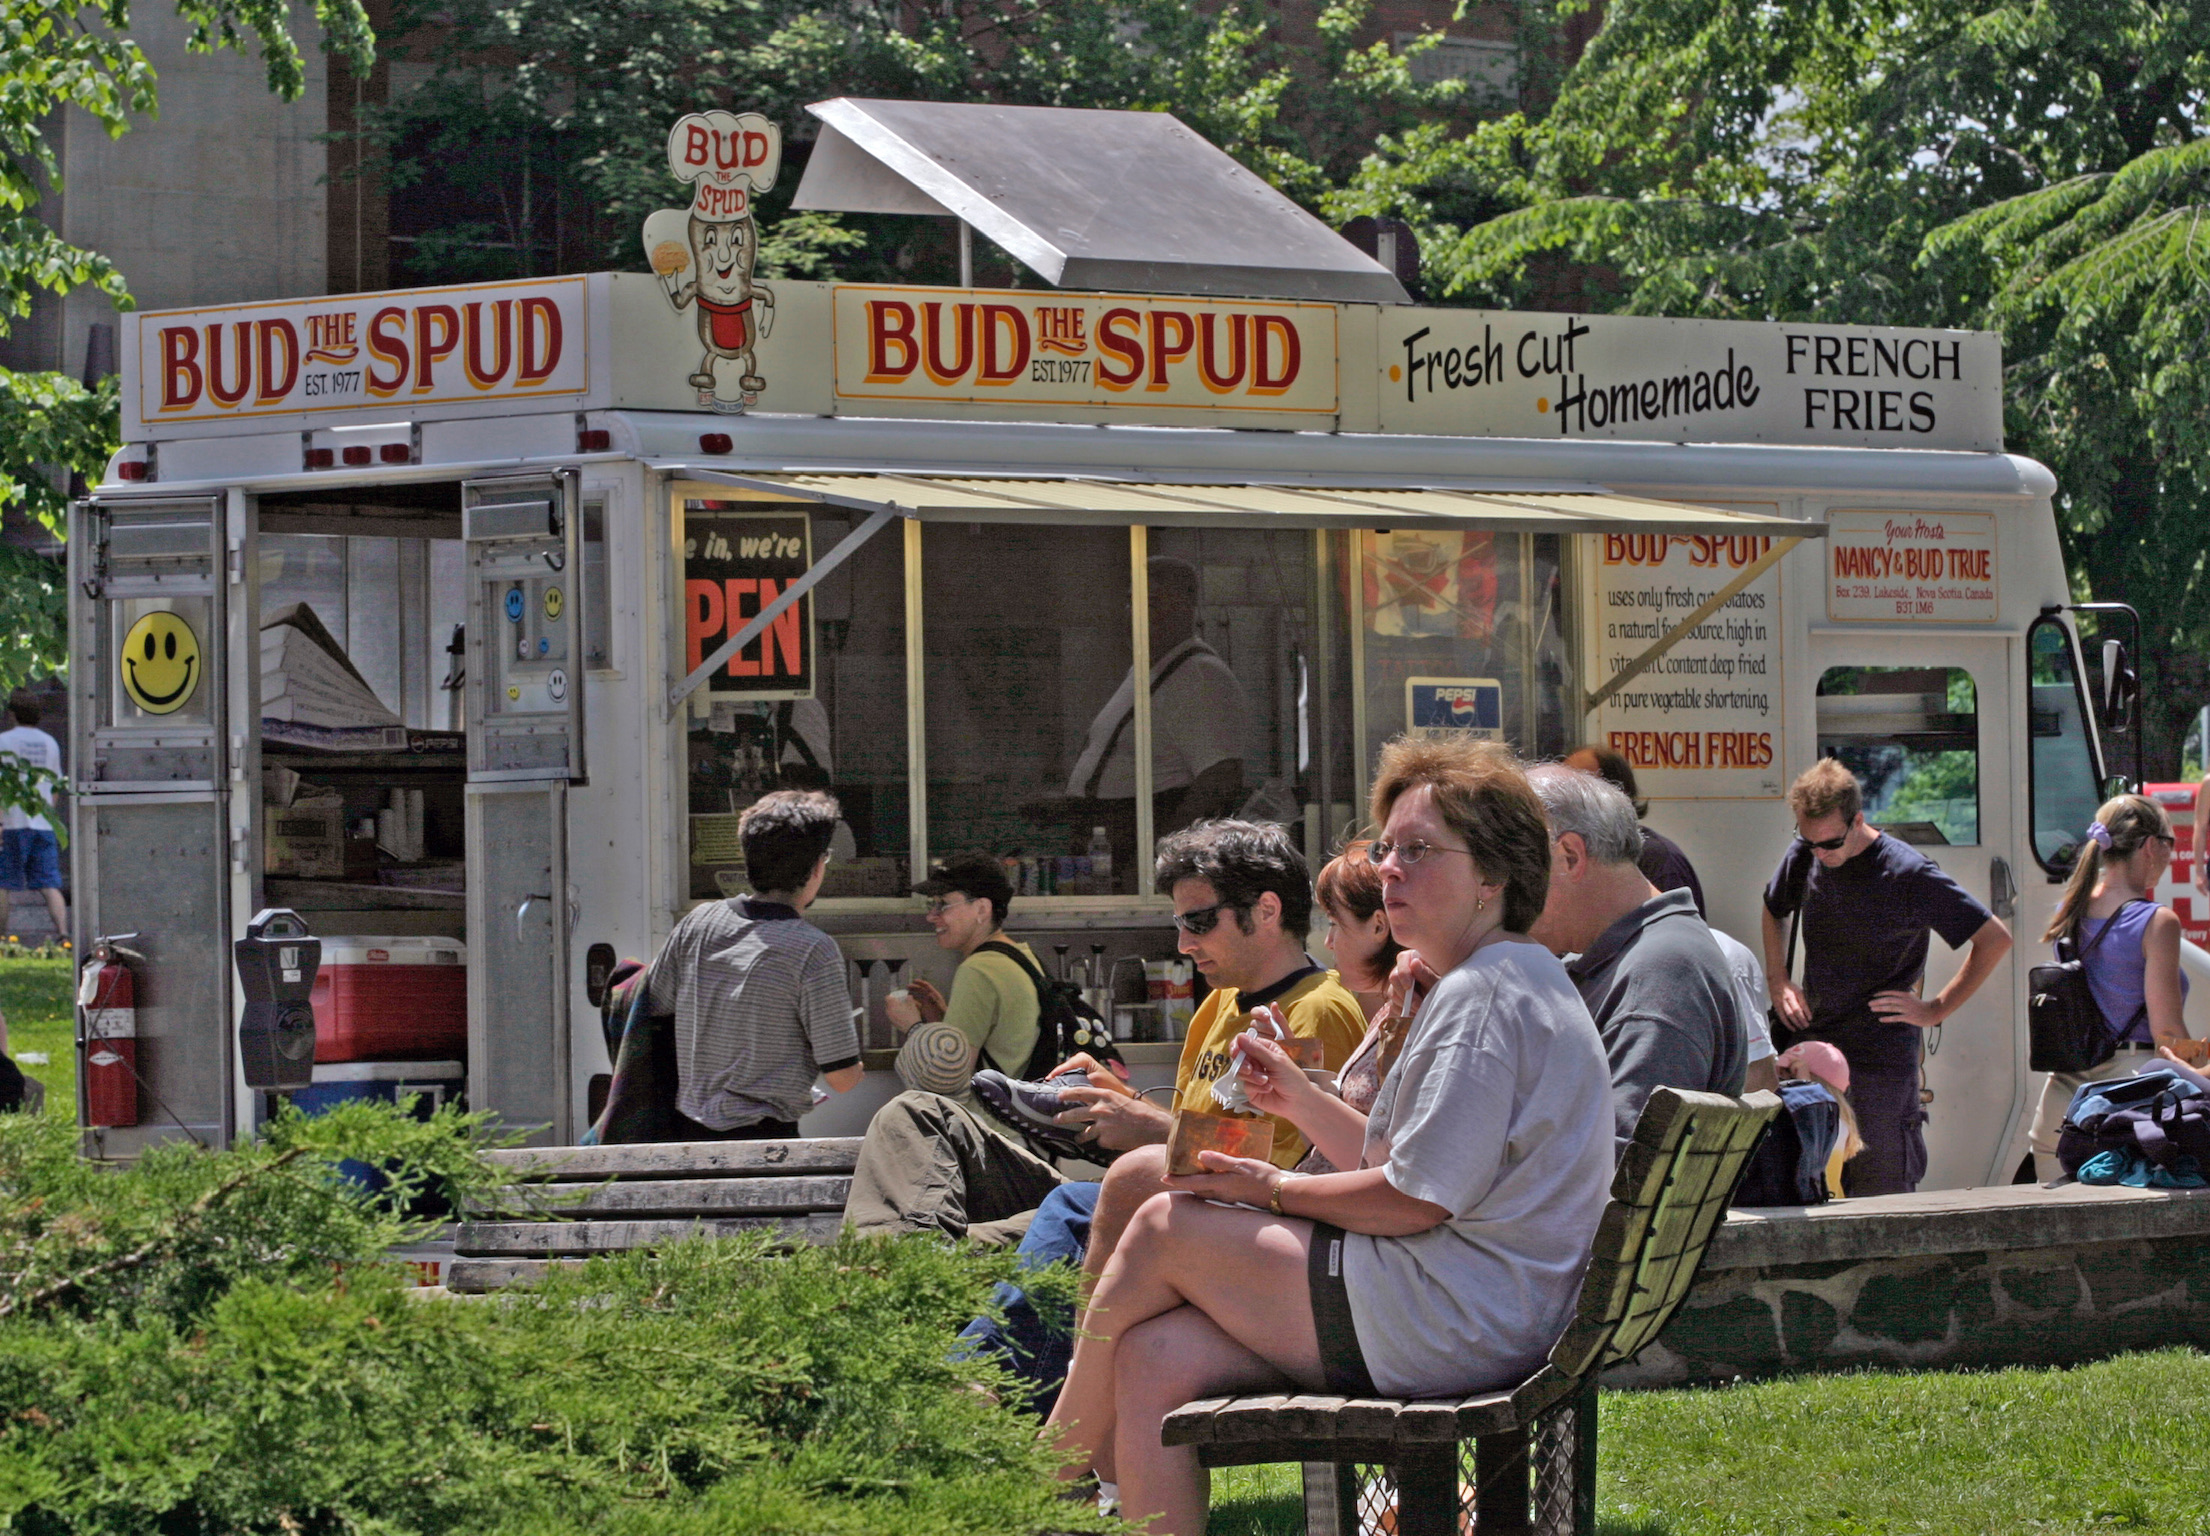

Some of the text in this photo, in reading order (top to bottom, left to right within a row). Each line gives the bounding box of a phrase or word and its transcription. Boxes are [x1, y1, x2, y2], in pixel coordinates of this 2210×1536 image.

[685, 123, 768, 170] BUD
[716, 171, 731, 181] THE
[697, 184, 746, 216] SPUD
[158, 296, 563, 412] BUD THE SPUD
[863, 300, 1301, 396] BUD THE SPUD
[1403, 324, 1503, 403] Fresh
[1786, 334, 1962, 381] FRENCH
[332, 371, 360, 393] 1977
[1555, 347, 1761, 434] Homemade
[1804, 389, 1937, 433] FRIES
[740, 531, 802, 560] we're
[1884, 518, 1946, 546] Your Hosts
[1834, 545, 1992, 581] NANCY & BUD TRUE
[1608, 590, 1635, 607] uses
[1637, 586, 1663, 613] only
[1665, 586, 1695, 608] fresh
[1718, 590, 1766, 614] otatoes
[1836, 585, 1850, 598] Box
[1916, 587, 1937, 600] Nova
[1965, 587, 1994, 600] Canada
[1608, 623, 1617, 639] a
[1619, 617, 1660, 640] natural
[1726, 617, 1753, 648] high
[1755, 618, 1767, 641] in
[1666, 655, 1708, 675] content
[1709, 652, 1735, 681] deep
[1738, 652, 1766, 675] fried
[1435, 688, 1477, 702] PEPSI
[1623, 692, 1649, 714] pure
[1650, 687, 1703, 715] vegetable
[1606, 731, 1773, 770] FRENCH FRIES
